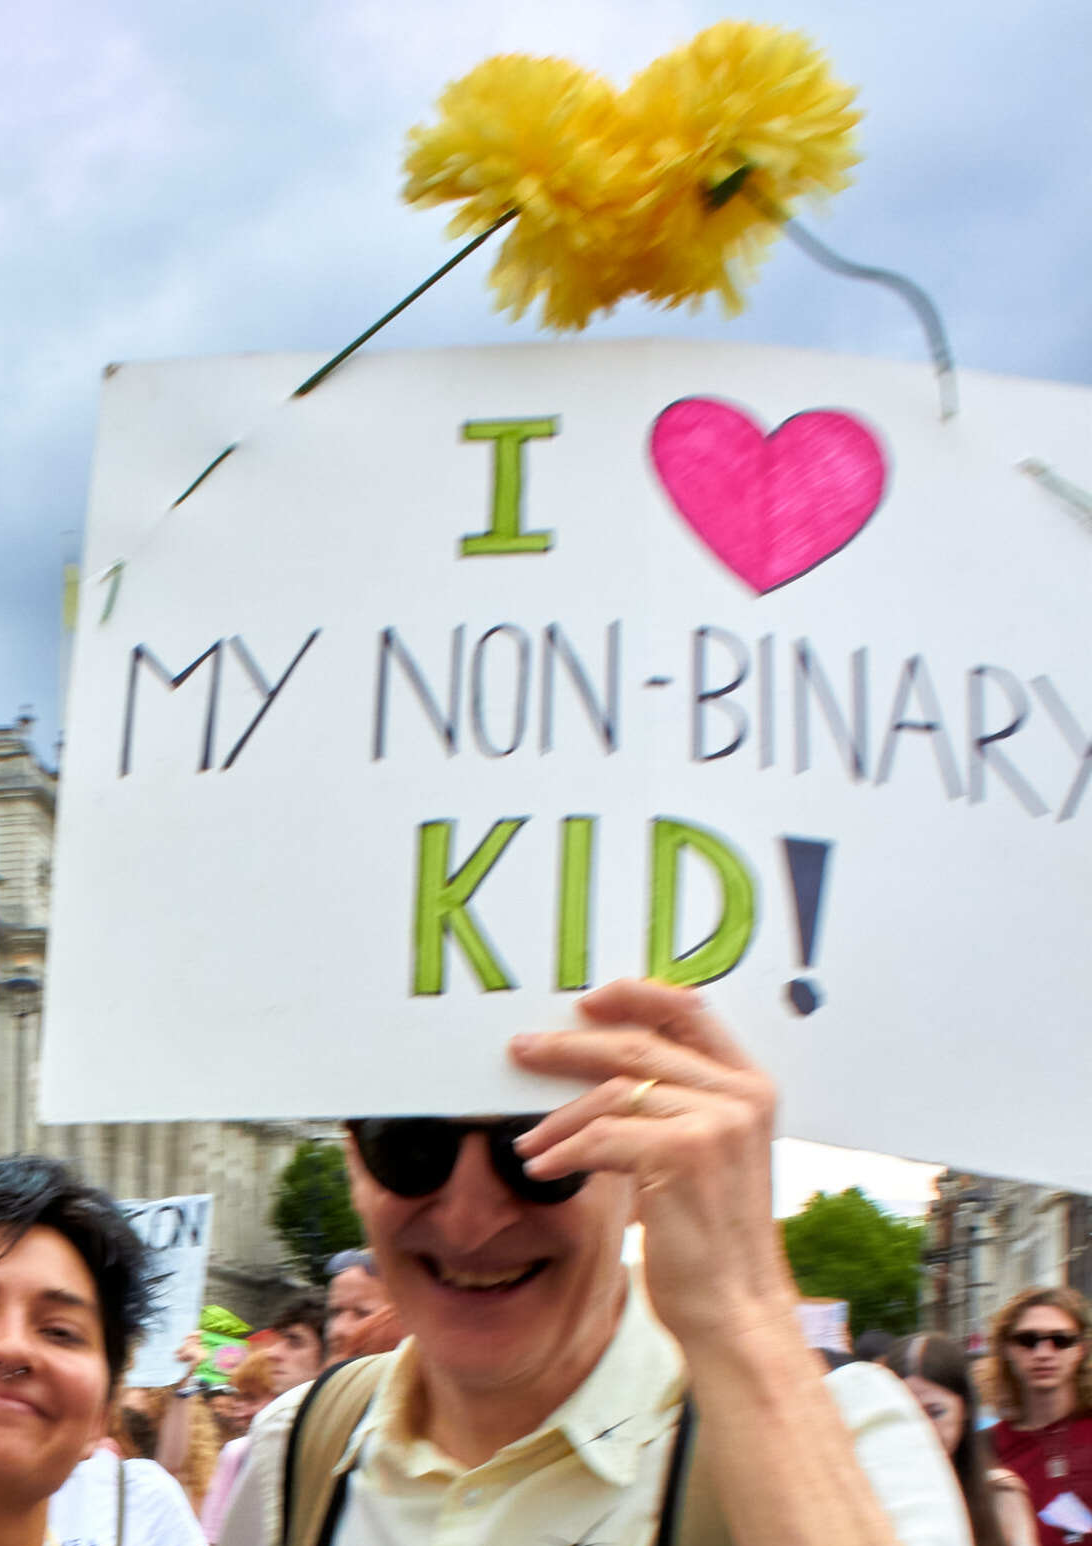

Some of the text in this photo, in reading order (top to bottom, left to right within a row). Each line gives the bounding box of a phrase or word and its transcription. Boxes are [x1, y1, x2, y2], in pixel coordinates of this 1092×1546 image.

[460, 415, 560, 557] I
[119, 618, 1092, 825] MY NON-BINARY
[410, 814, 835, 1018] KID!
